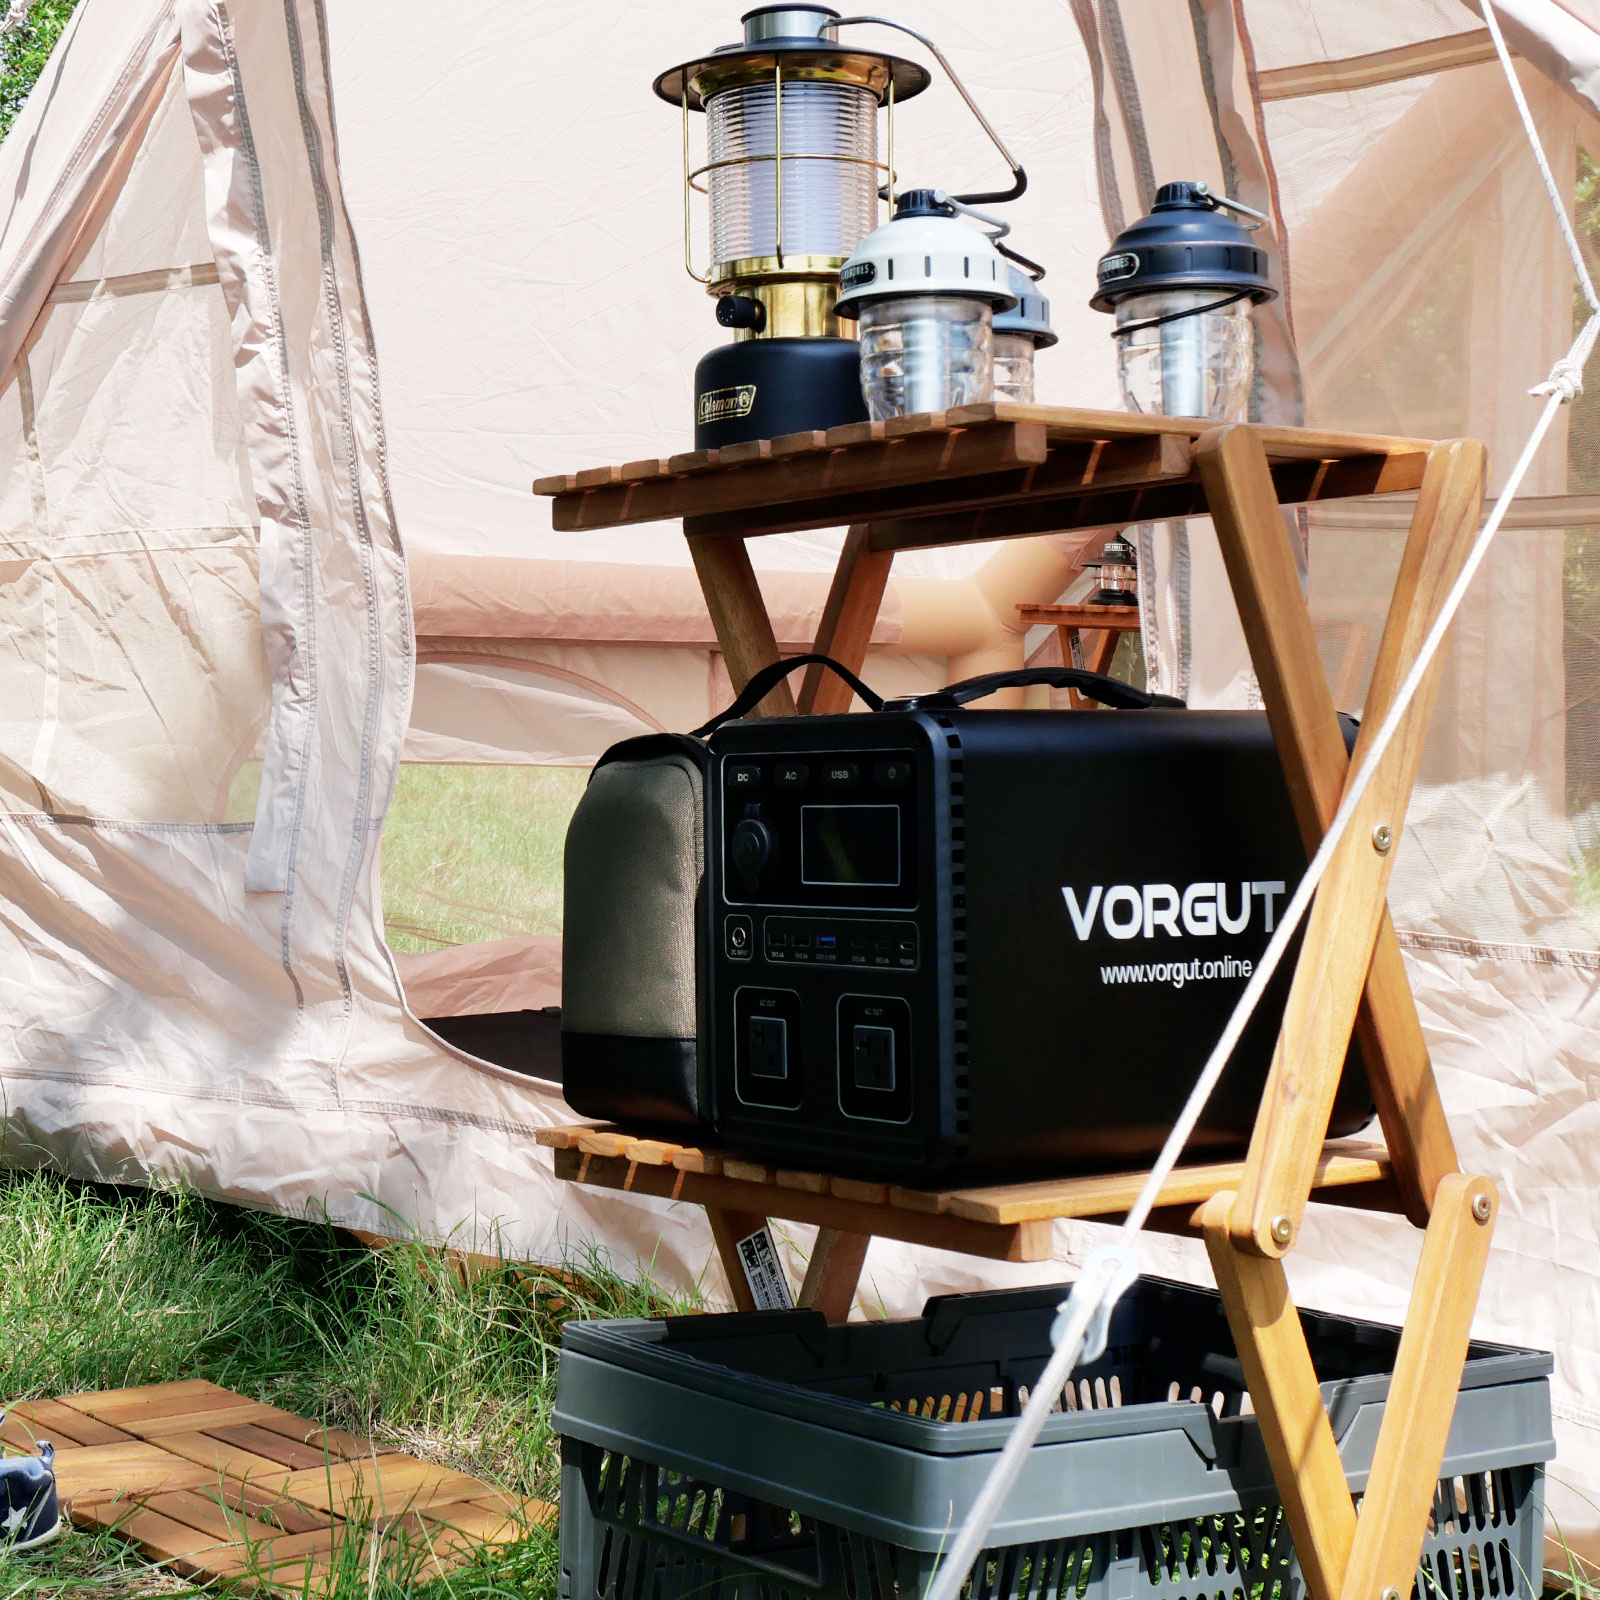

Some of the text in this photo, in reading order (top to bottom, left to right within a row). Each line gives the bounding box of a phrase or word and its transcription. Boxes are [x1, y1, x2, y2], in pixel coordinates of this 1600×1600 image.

[700, 394, 739, 416] Coleman
[737, 773, 749, 782] DC
[784, 771, 797, 780] AC
[831, 770, 849, 779] USB
[1061, 880, 1286, 941] VORGUT
[1100, 955, 1253, 989] www.vorgut.online
